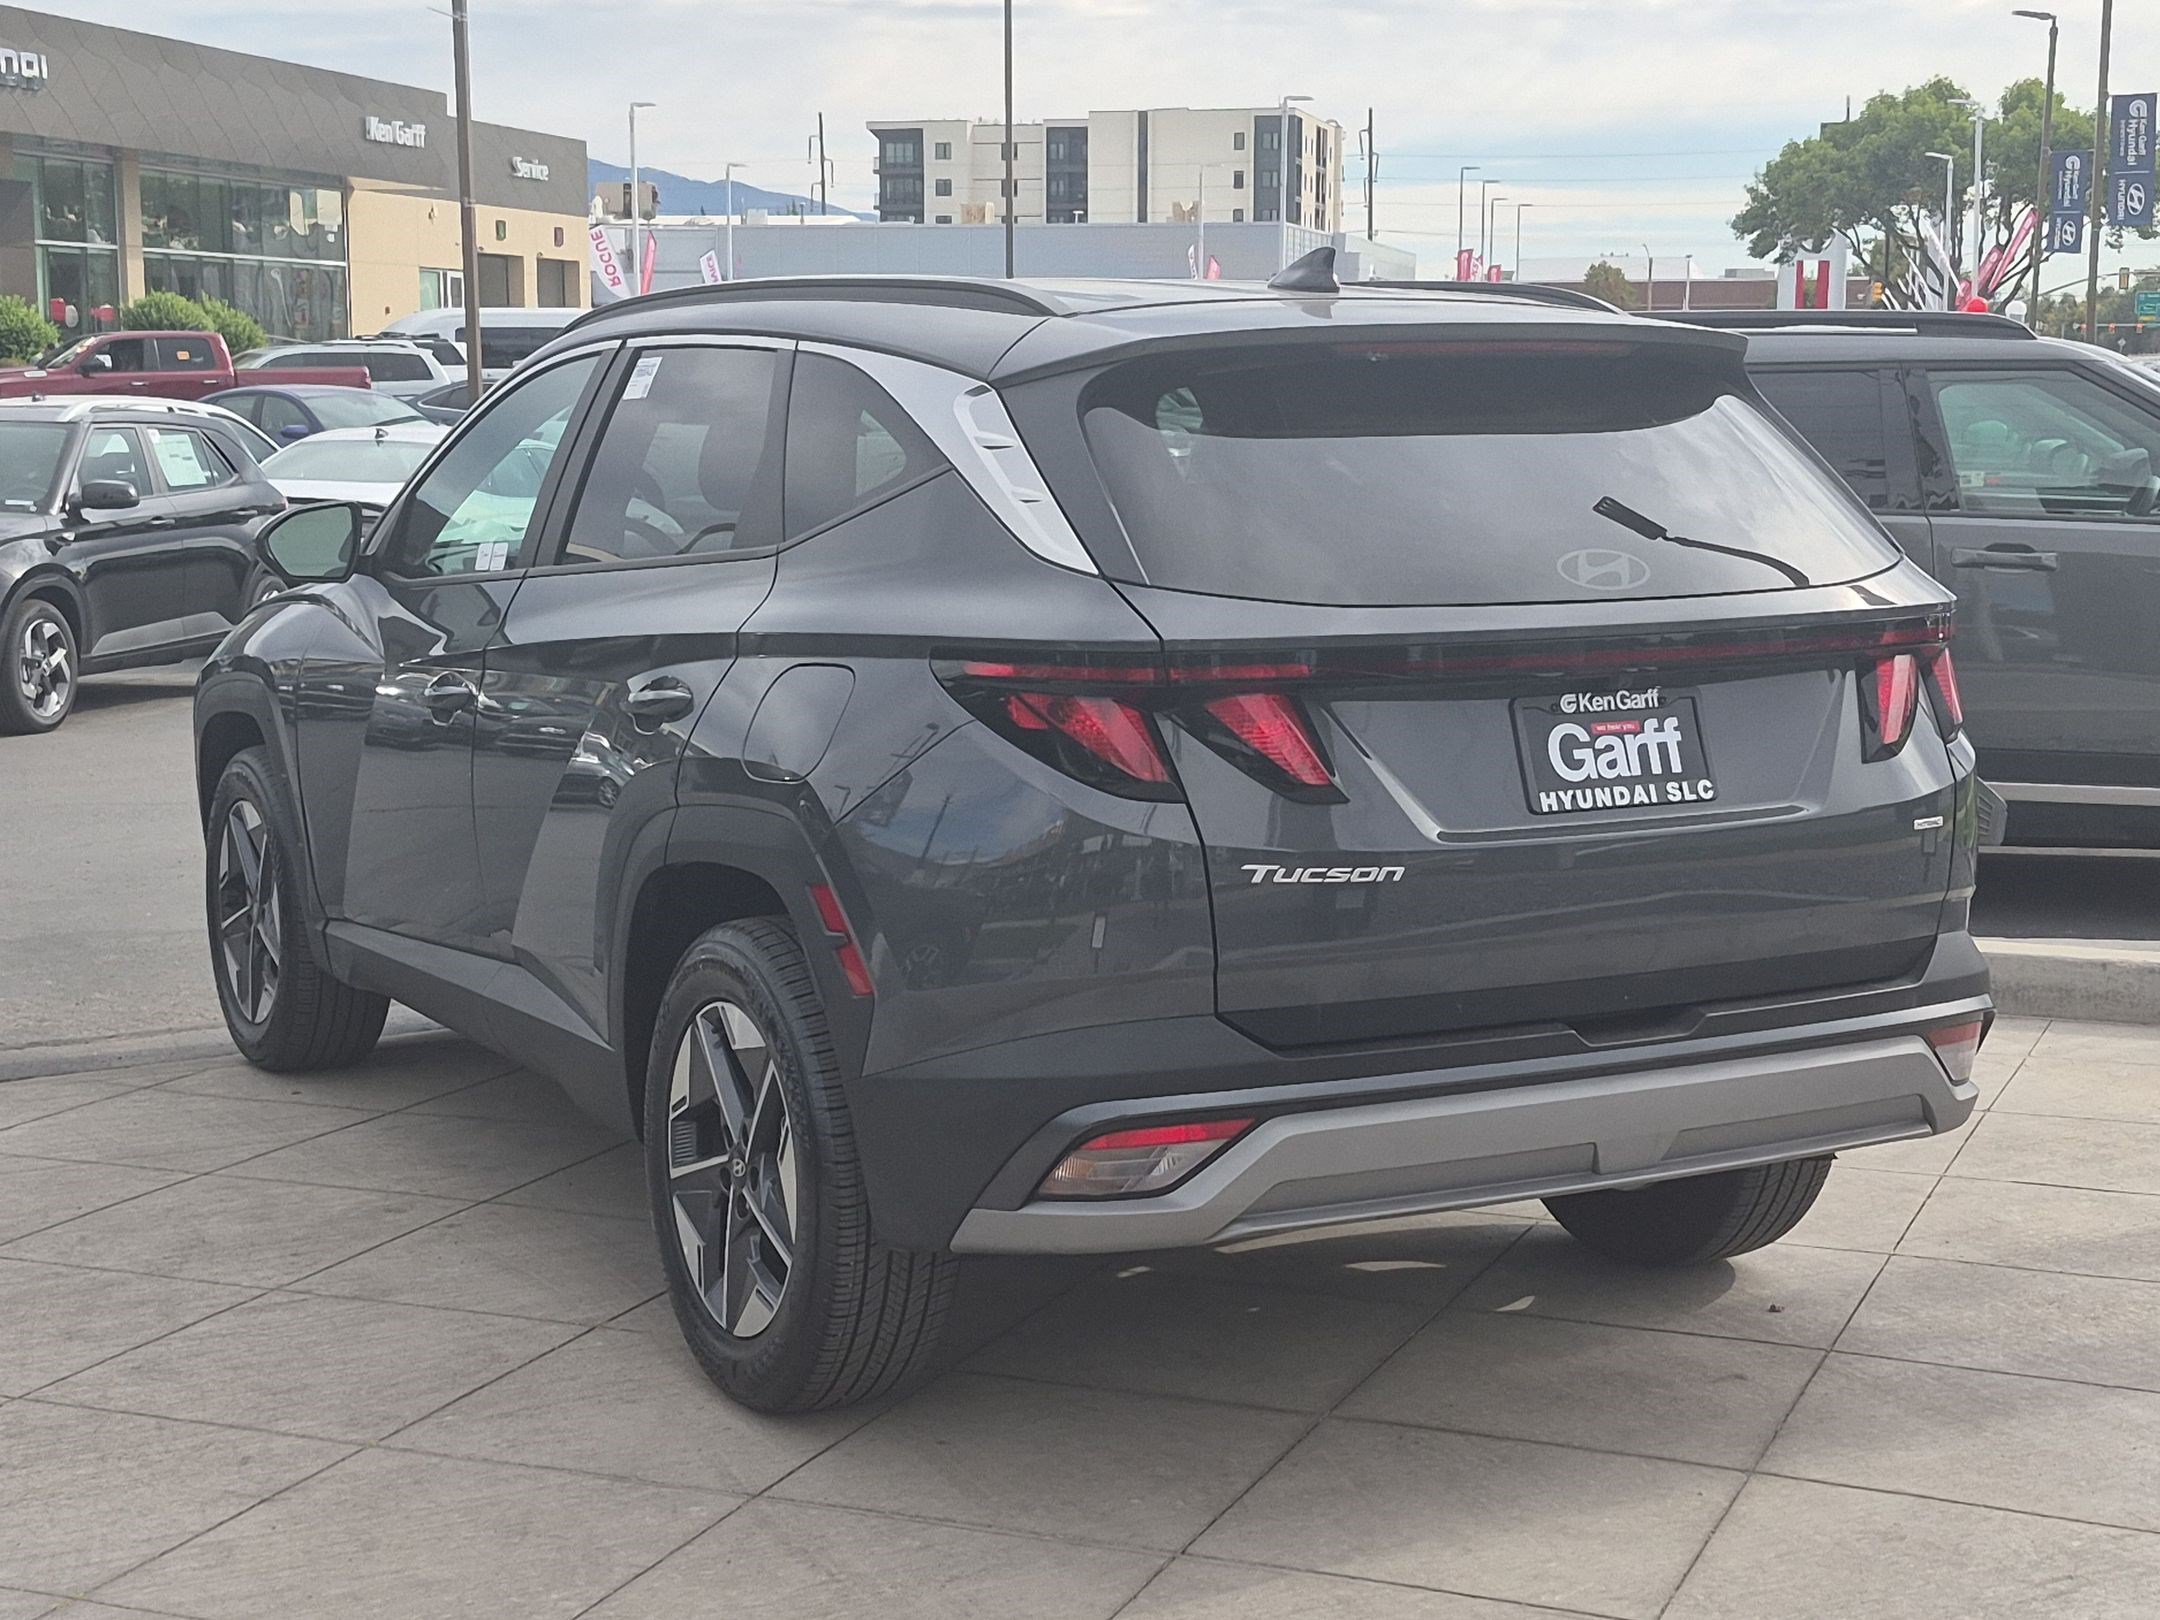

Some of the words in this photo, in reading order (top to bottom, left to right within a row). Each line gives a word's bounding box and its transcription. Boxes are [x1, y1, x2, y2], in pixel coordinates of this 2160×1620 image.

[366, 116, 392, 143] Ken
[392, 121, 426, 148] Garff
[2127, 119, 2138, 165] Hyundai
[512, 156, 549, 181] Service
[2117, 179, 2127, 220] HYUNDAI
[1548, 716, 1682, 782] Garff
[1539, 783, 1658, 812] HYUNDAI
[1666, 779, 1714, 802] SLC
